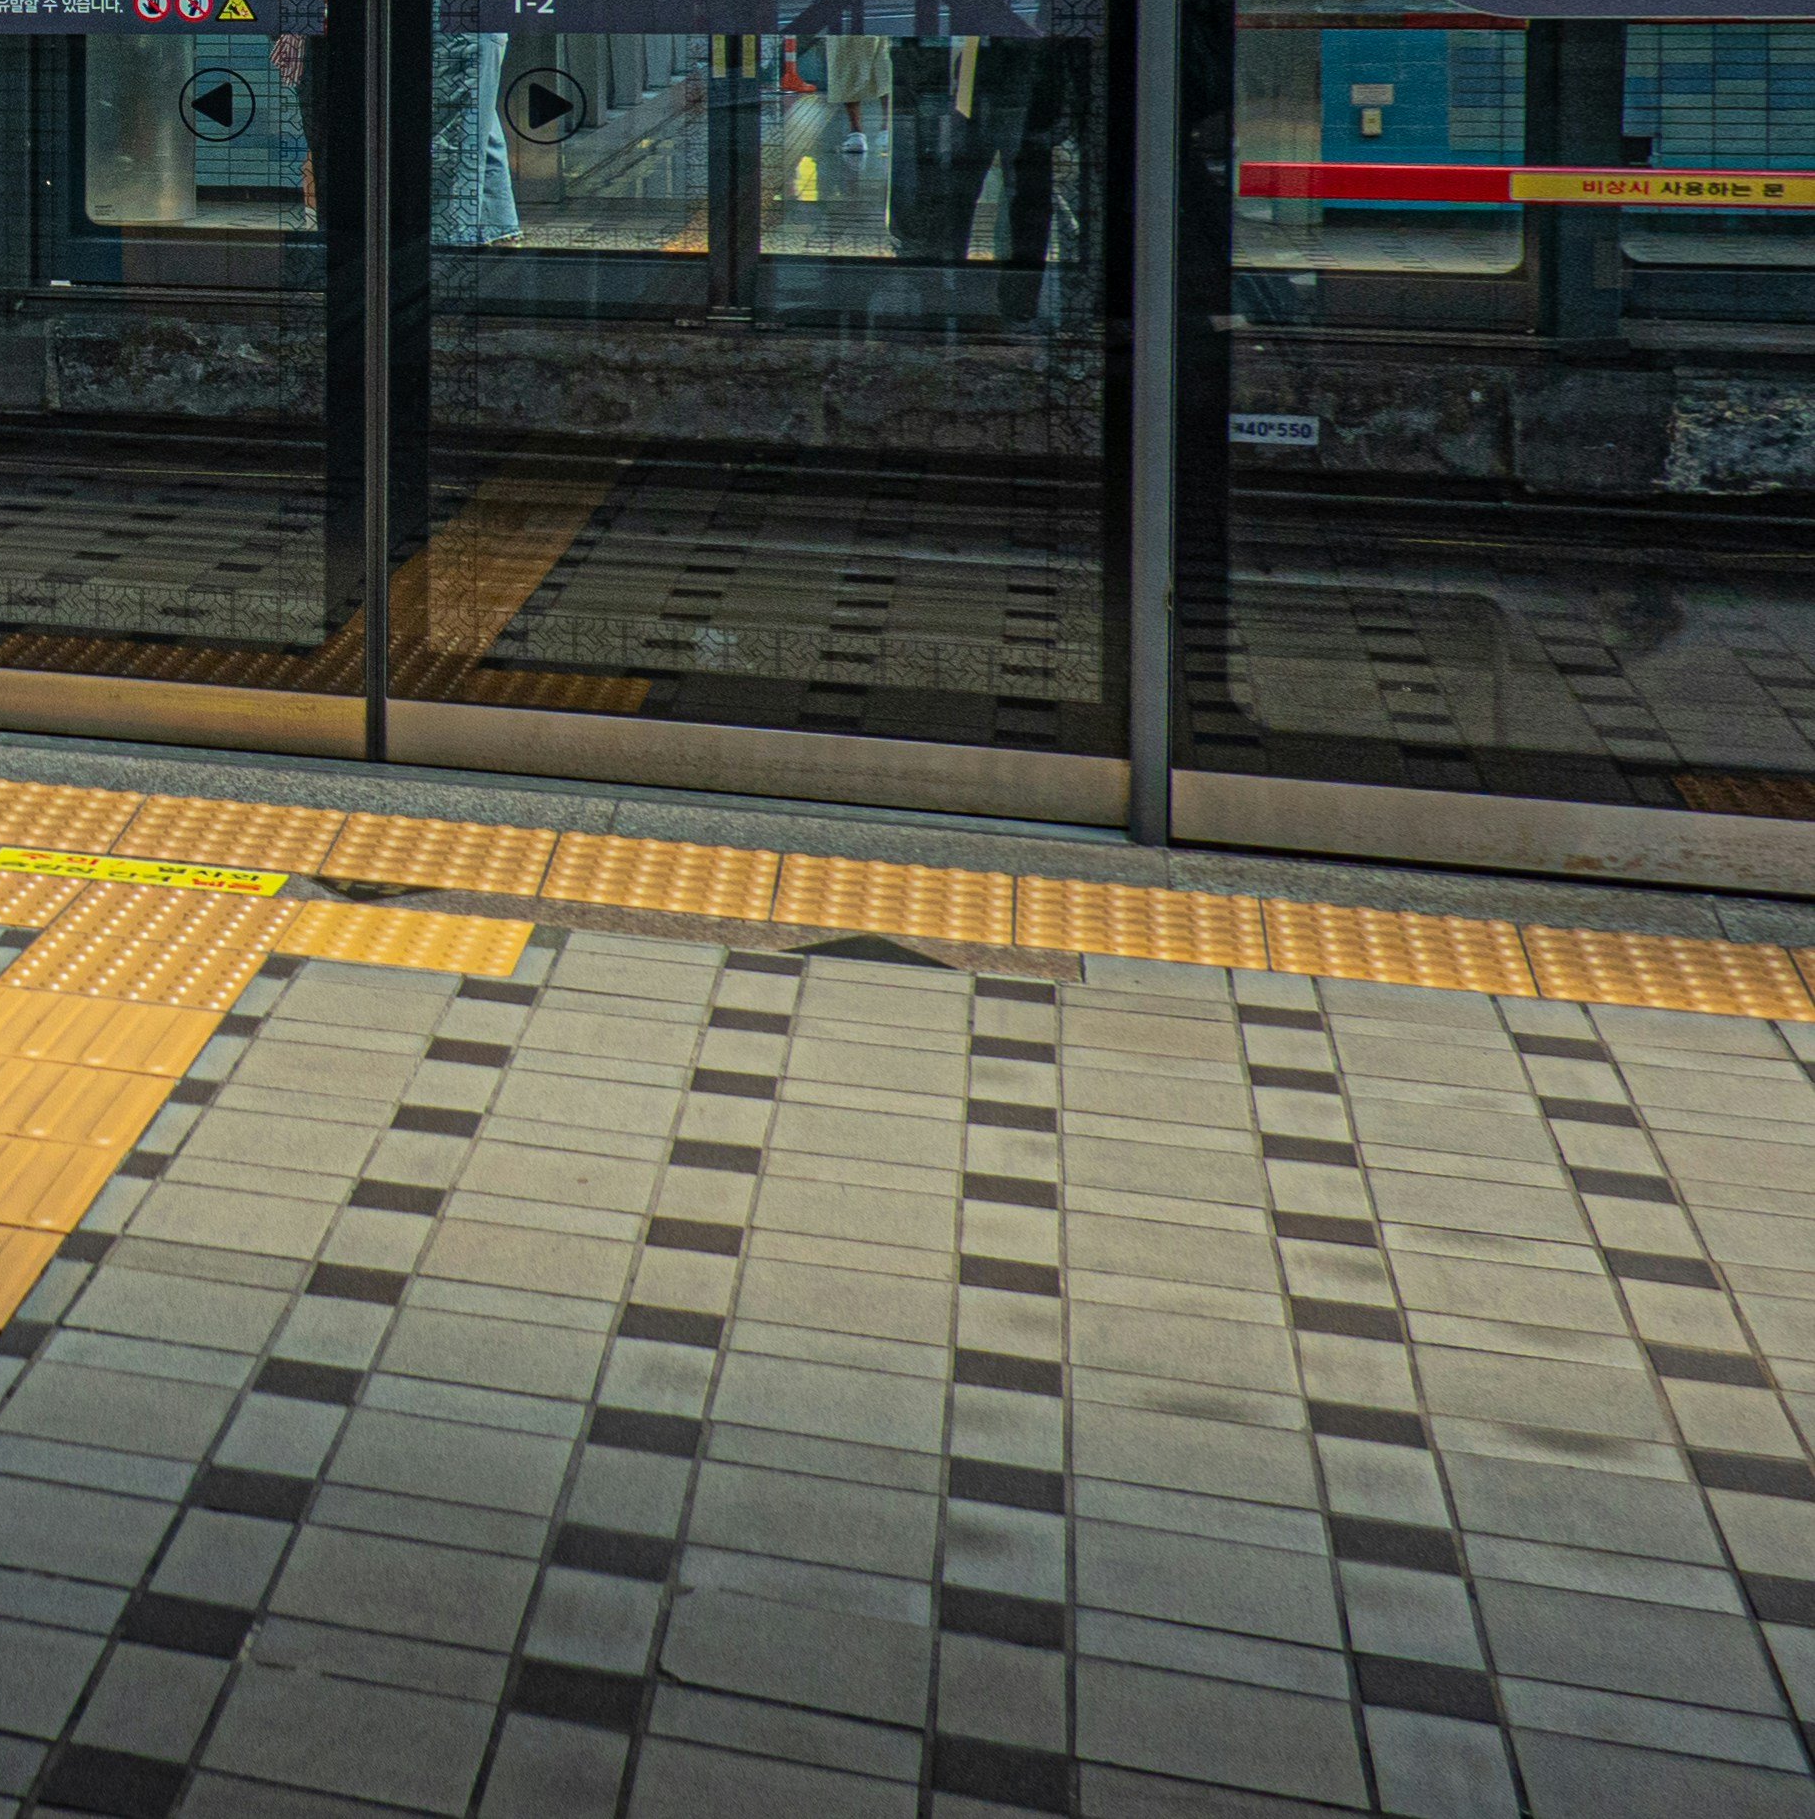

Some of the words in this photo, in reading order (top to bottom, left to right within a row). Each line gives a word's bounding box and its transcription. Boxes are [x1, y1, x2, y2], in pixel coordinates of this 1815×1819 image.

[1581, 180, 1650, 195] 비상시
[1661, 181, 1752, 197] 사용하는
[1761, 183, 1785, 197] 문
